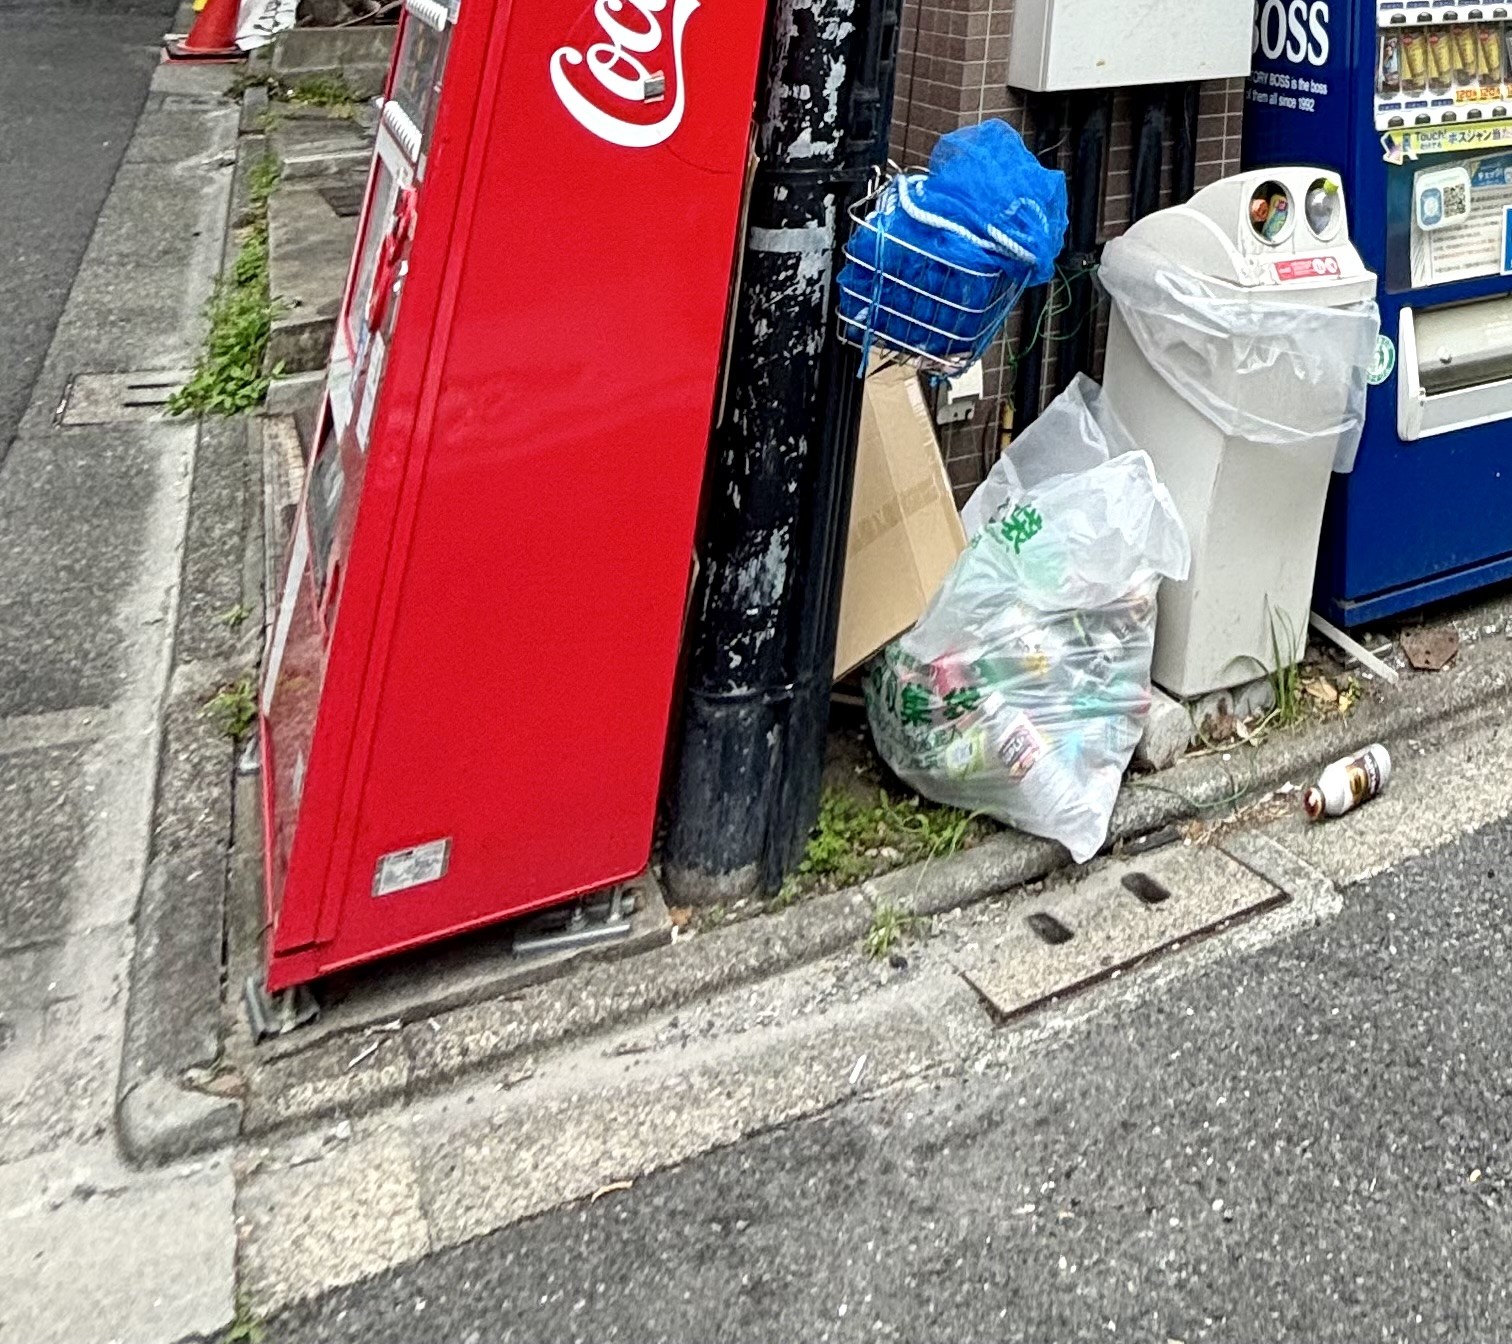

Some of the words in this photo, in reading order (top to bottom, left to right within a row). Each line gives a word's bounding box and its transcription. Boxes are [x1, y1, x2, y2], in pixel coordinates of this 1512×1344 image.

[1269, 73, 1290, 89] BOSS
[1291, 76, 1298, 90] is
[1299, 77, 1310, 92] the
[1310, 80, 1329, 96] boss
[1252, 89, 1269, 103] them
[1269, 92, 1278, 105] all
[1278, 93, 1297, 109] since
[1298, 97, 1316, 113] 1992
